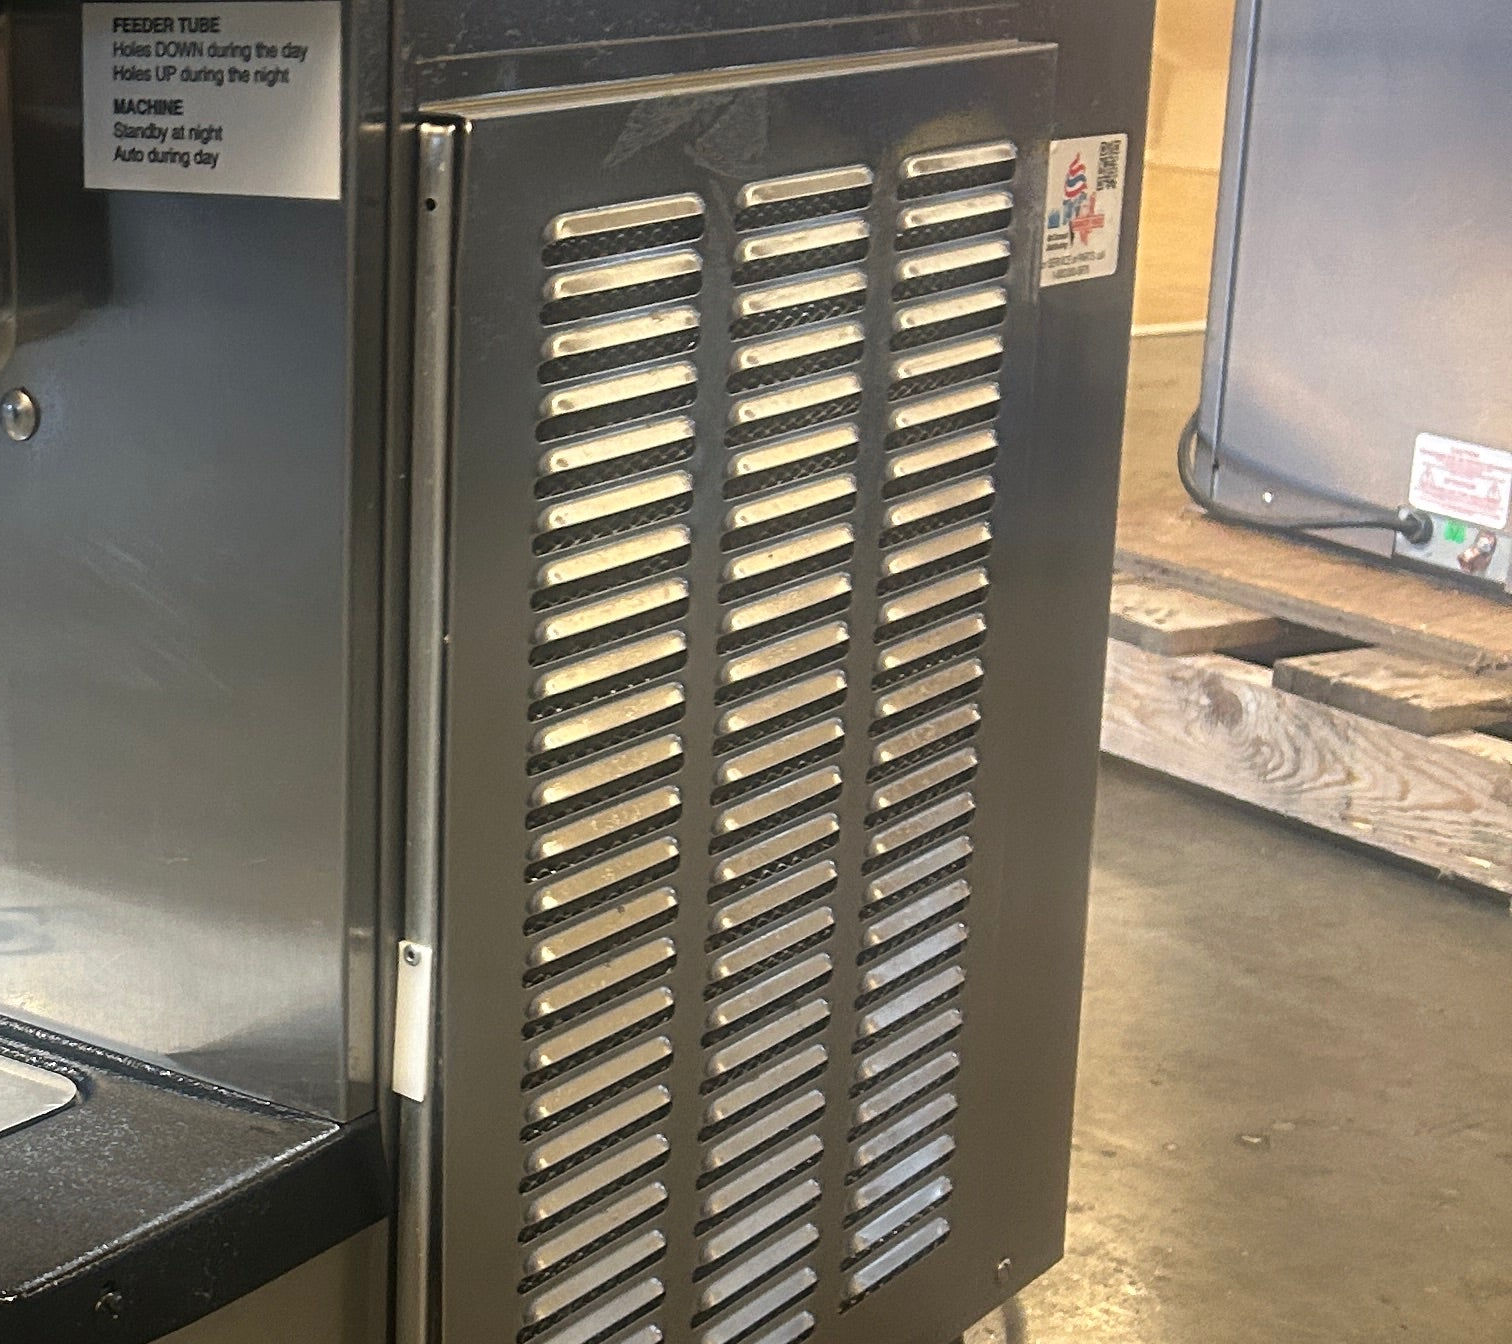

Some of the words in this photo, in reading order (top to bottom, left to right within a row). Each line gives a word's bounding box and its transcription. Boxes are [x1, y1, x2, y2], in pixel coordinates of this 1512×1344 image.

[113, 17, 173, 34] FEEDER
[178, 16, 221, 33] TUBE
[113, 41, 152, 59] Holes
[155, 41, 204, 58] DOWN
[208, 41, 251, 62] during
[256, 42, 278, 59] the
[281, 42, 308, 63] day
[113, 66, 152, 82] Holes
[155, 66, 177, 81] UP
[181, 66, 225, 86] during
[228, 66, 250, 83] the
[254, 66, 290, 86] night
[113, 98, 184, 115] MACHINE
[113, 121, 169, 143] Standby
[172, 125, 185, 140] at
[188, 125, 223, 144] night
[113, 146, 144, 163] Auto
[148, 148, 191, 167] during
[194, 149, 219, 169] day
